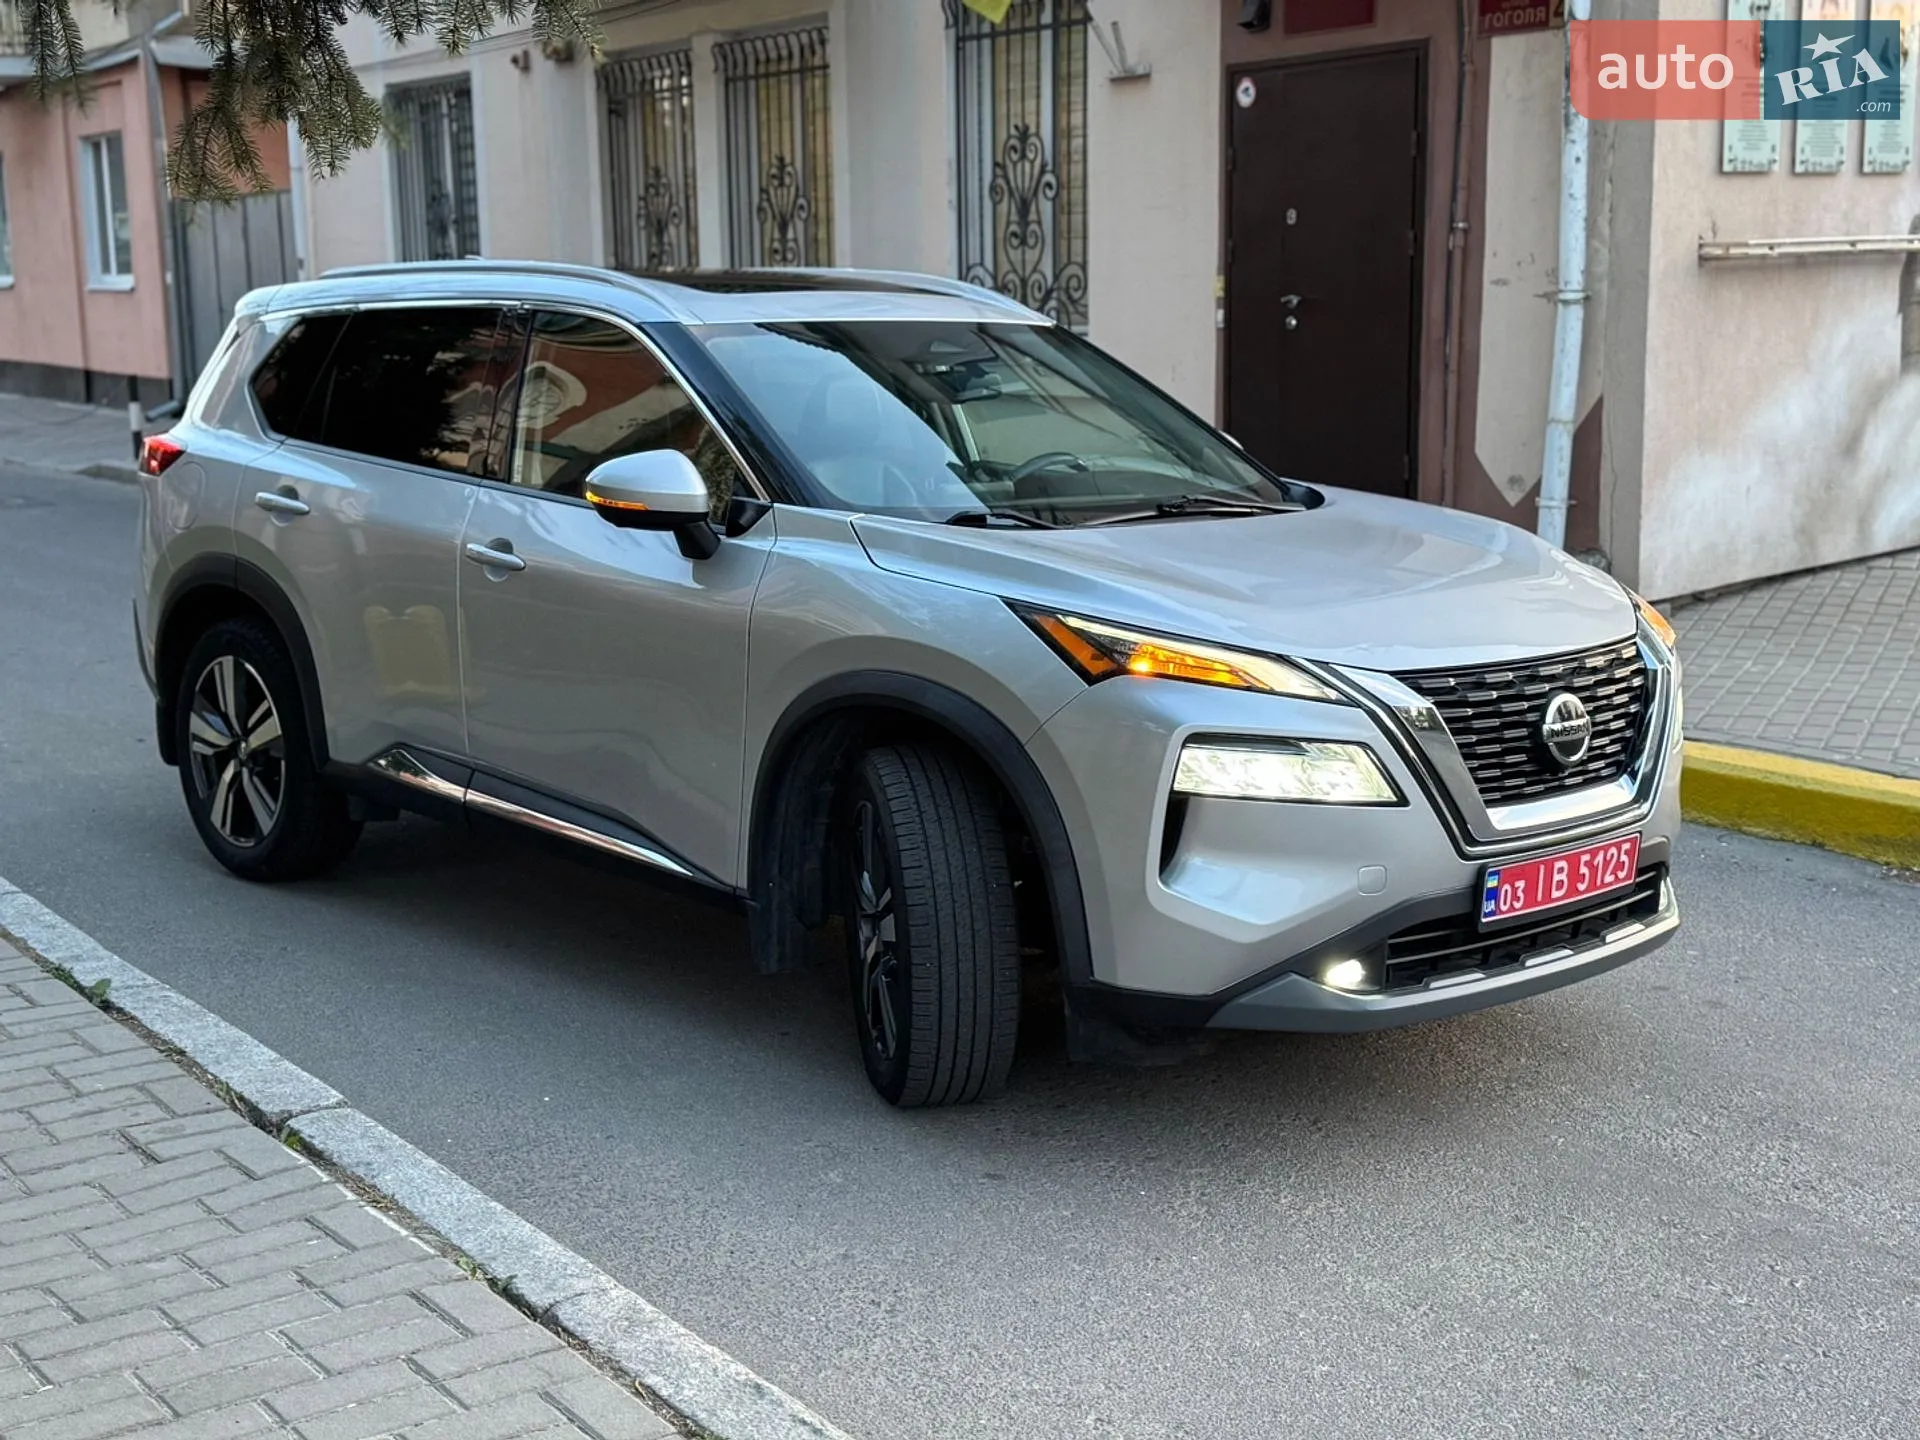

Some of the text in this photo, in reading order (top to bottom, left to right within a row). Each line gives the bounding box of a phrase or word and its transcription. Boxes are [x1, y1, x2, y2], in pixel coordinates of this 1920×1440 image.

[1550, 721, 1589, 738] NISSAN
[1500, 880, 1525, 912] 03
[1576, 842, 1631, 892] 5125
